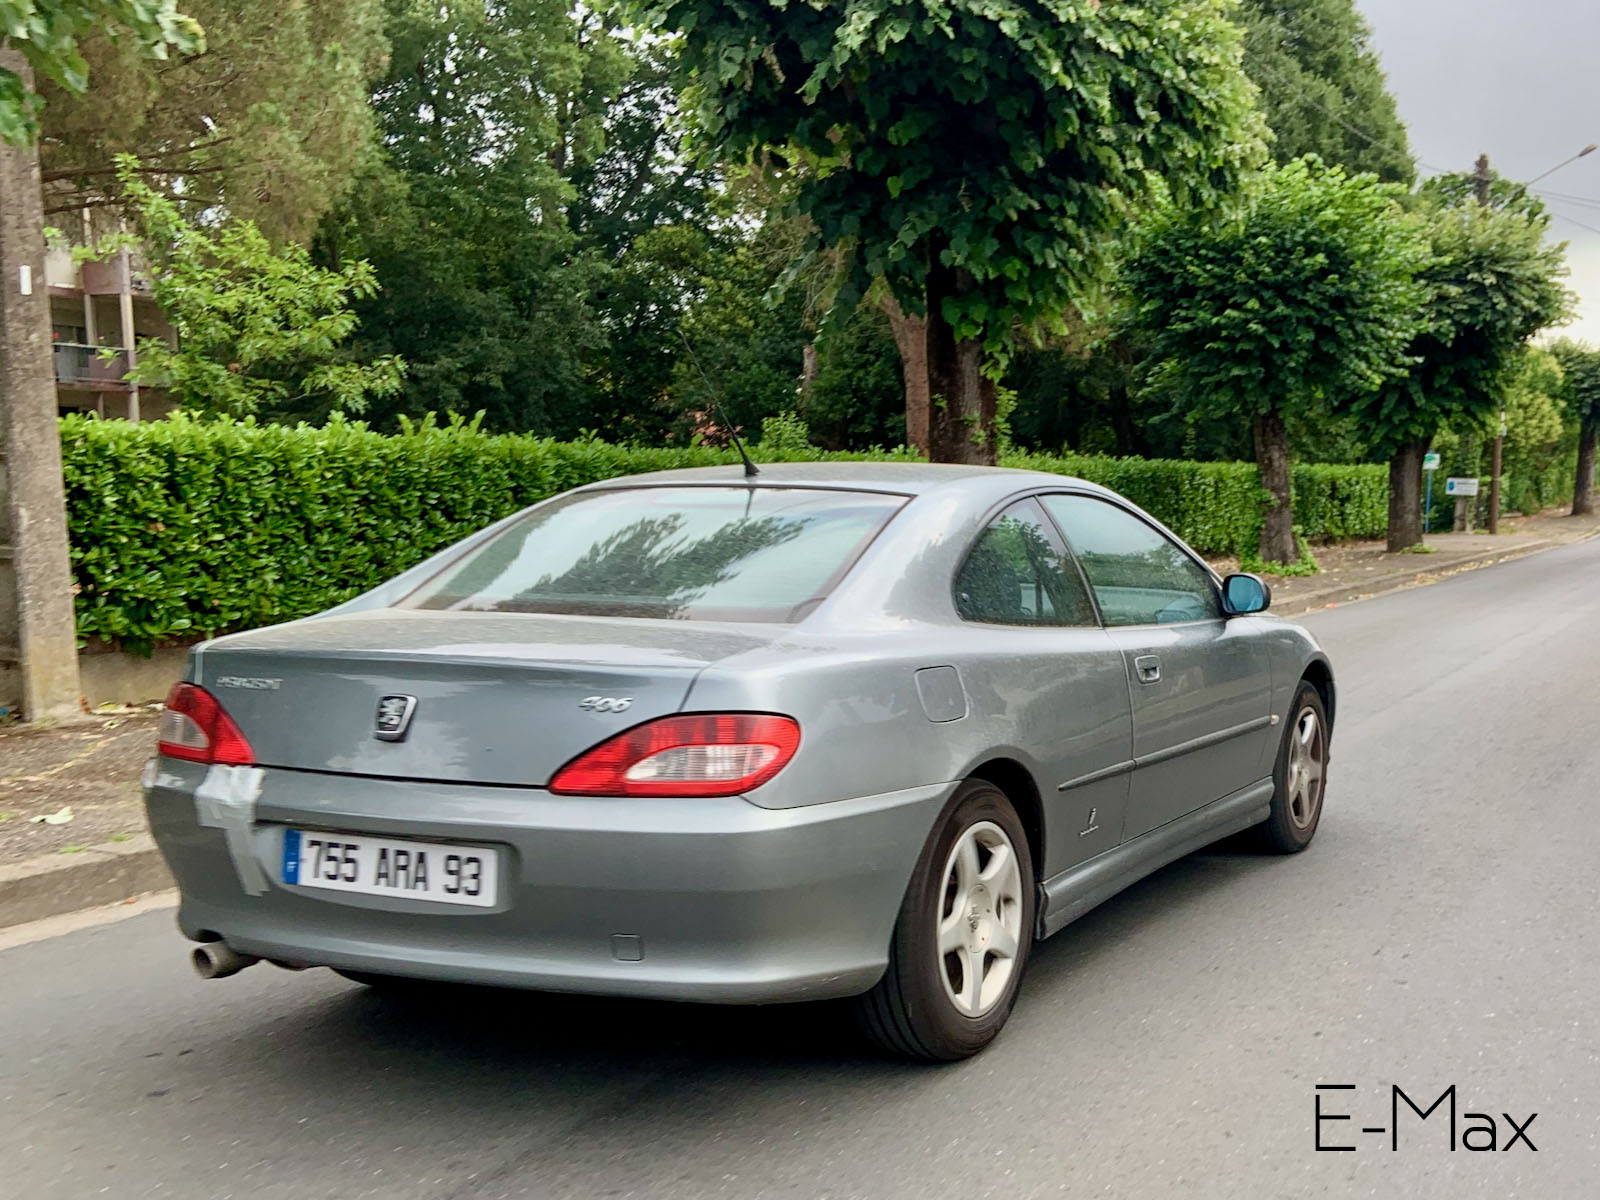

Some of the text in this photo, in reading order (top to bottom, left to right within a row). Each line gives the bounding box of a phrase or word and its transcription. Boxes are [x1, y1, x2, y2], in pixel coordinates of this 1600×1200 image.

[578, 696, 633, 713] 406
[308, 839, 482, 897] 755 ARA 93
